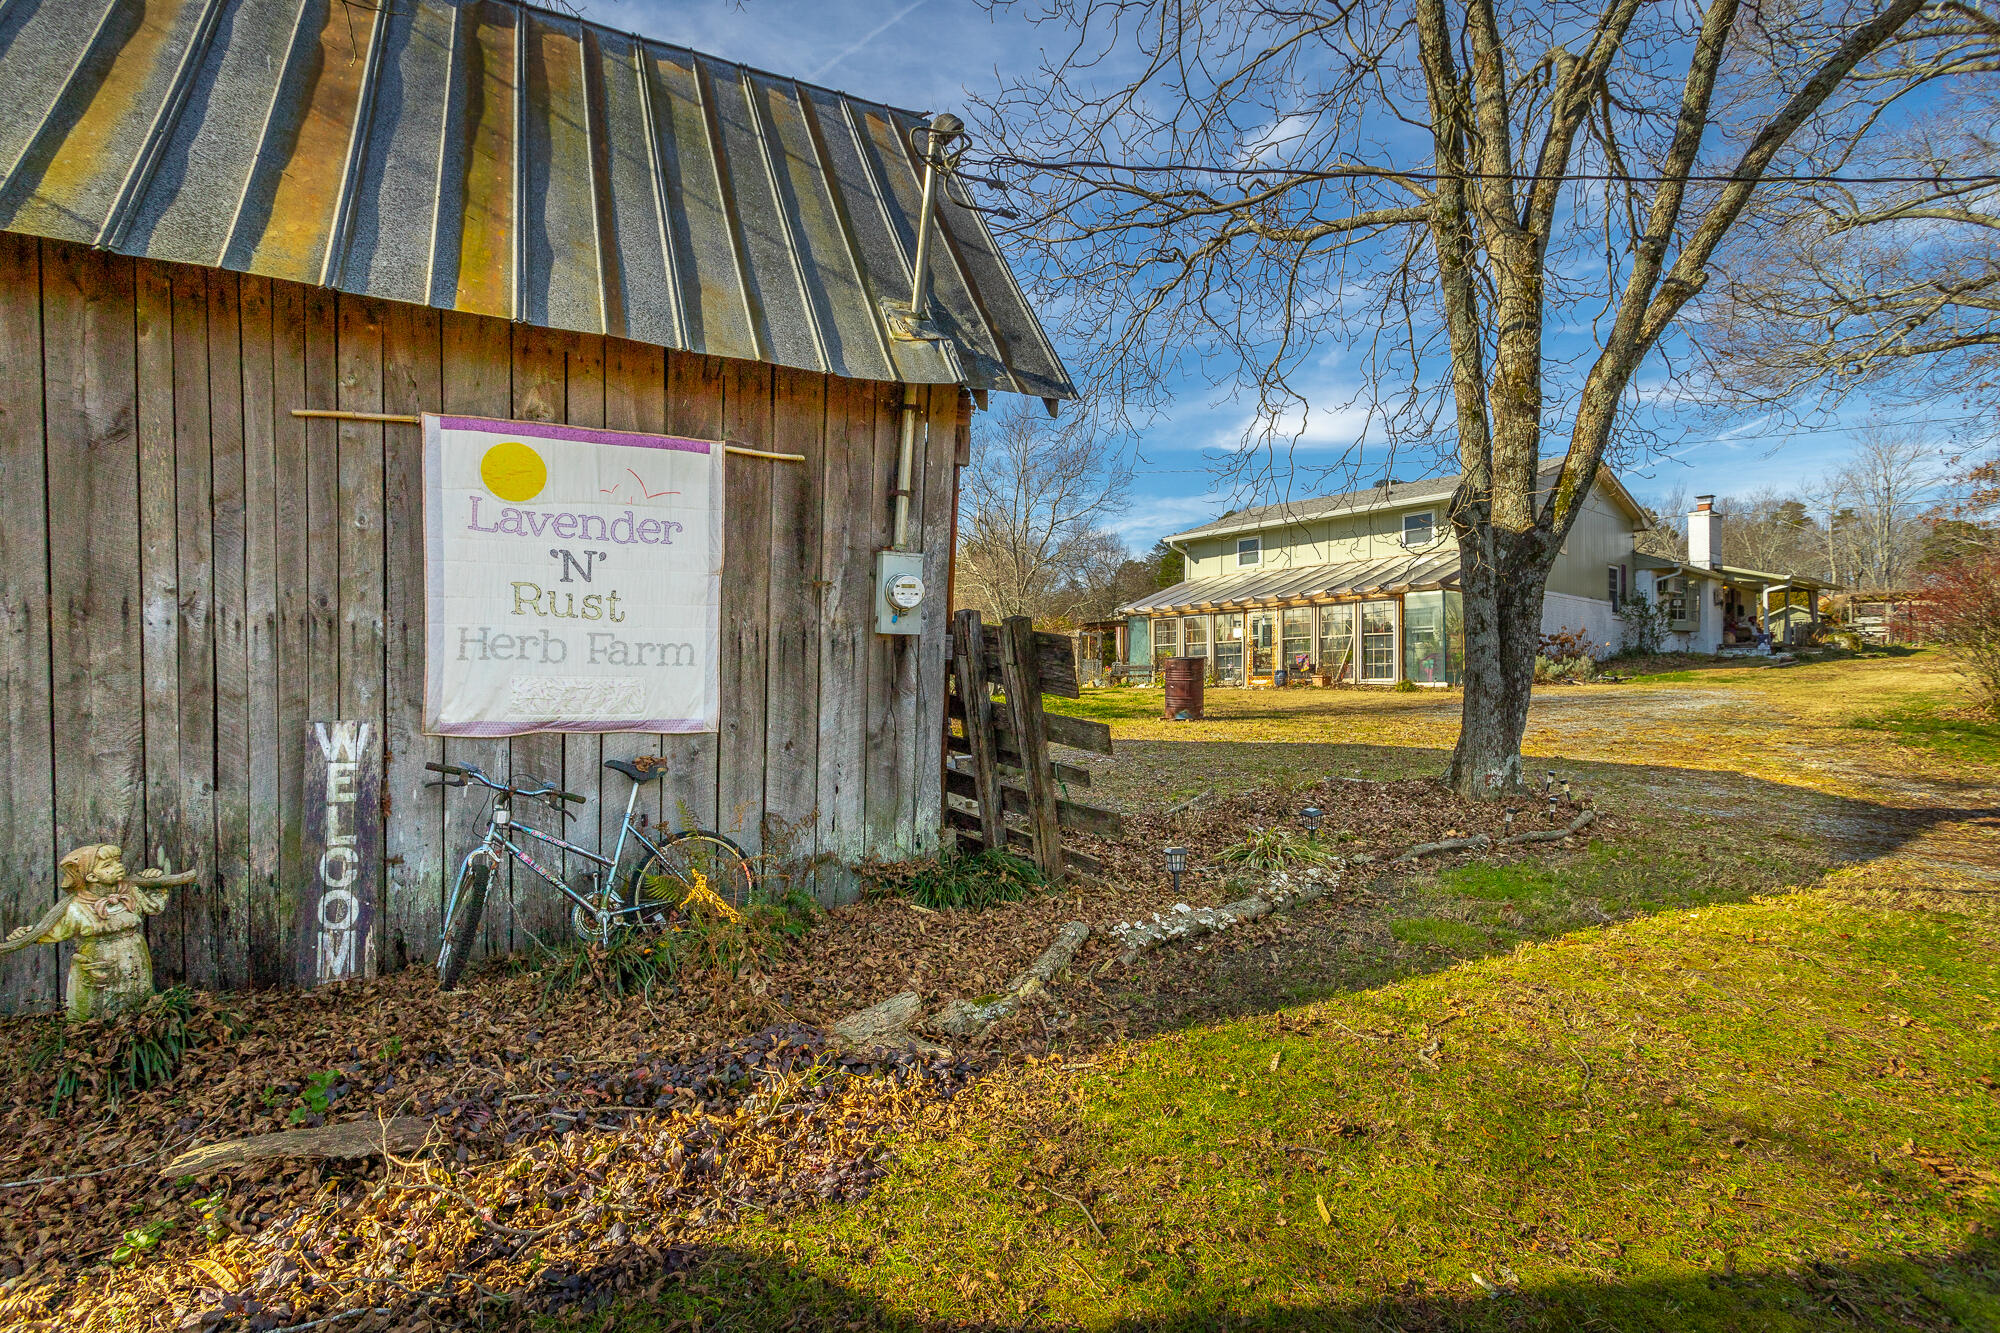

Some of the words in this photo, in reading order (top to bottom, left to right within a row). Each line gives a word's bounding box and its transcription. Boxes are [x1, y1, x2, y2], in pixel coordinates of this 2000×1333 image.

[467, 495, 683, 545] Lavender
[549, 549, 607, 583] 'N'
[510, 581, 626, 623] Rust
[456, 626, 568, 665] Herb
[586, 631, 698, 667] Farm
[316, 722, 369, 985] WELCOM
